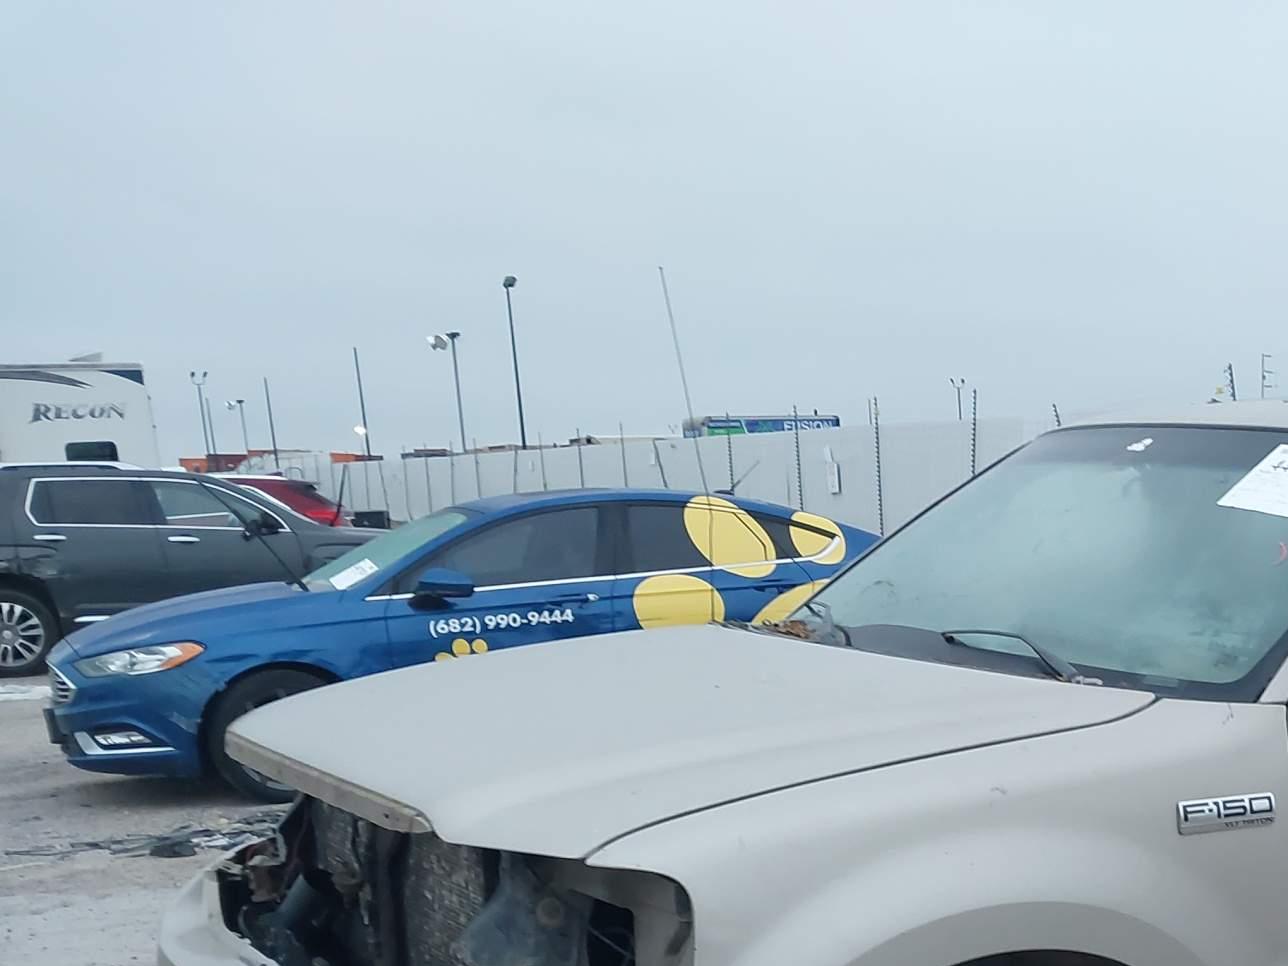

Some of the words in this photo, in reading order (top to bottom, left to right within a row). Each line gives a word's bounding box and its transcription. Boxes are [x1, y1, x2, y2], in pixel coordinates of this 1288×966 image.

[28, 402, 125, 424] RECON
[429, 616, 481, 638] (682)
[484, 609, 575, 630] 990-9444
